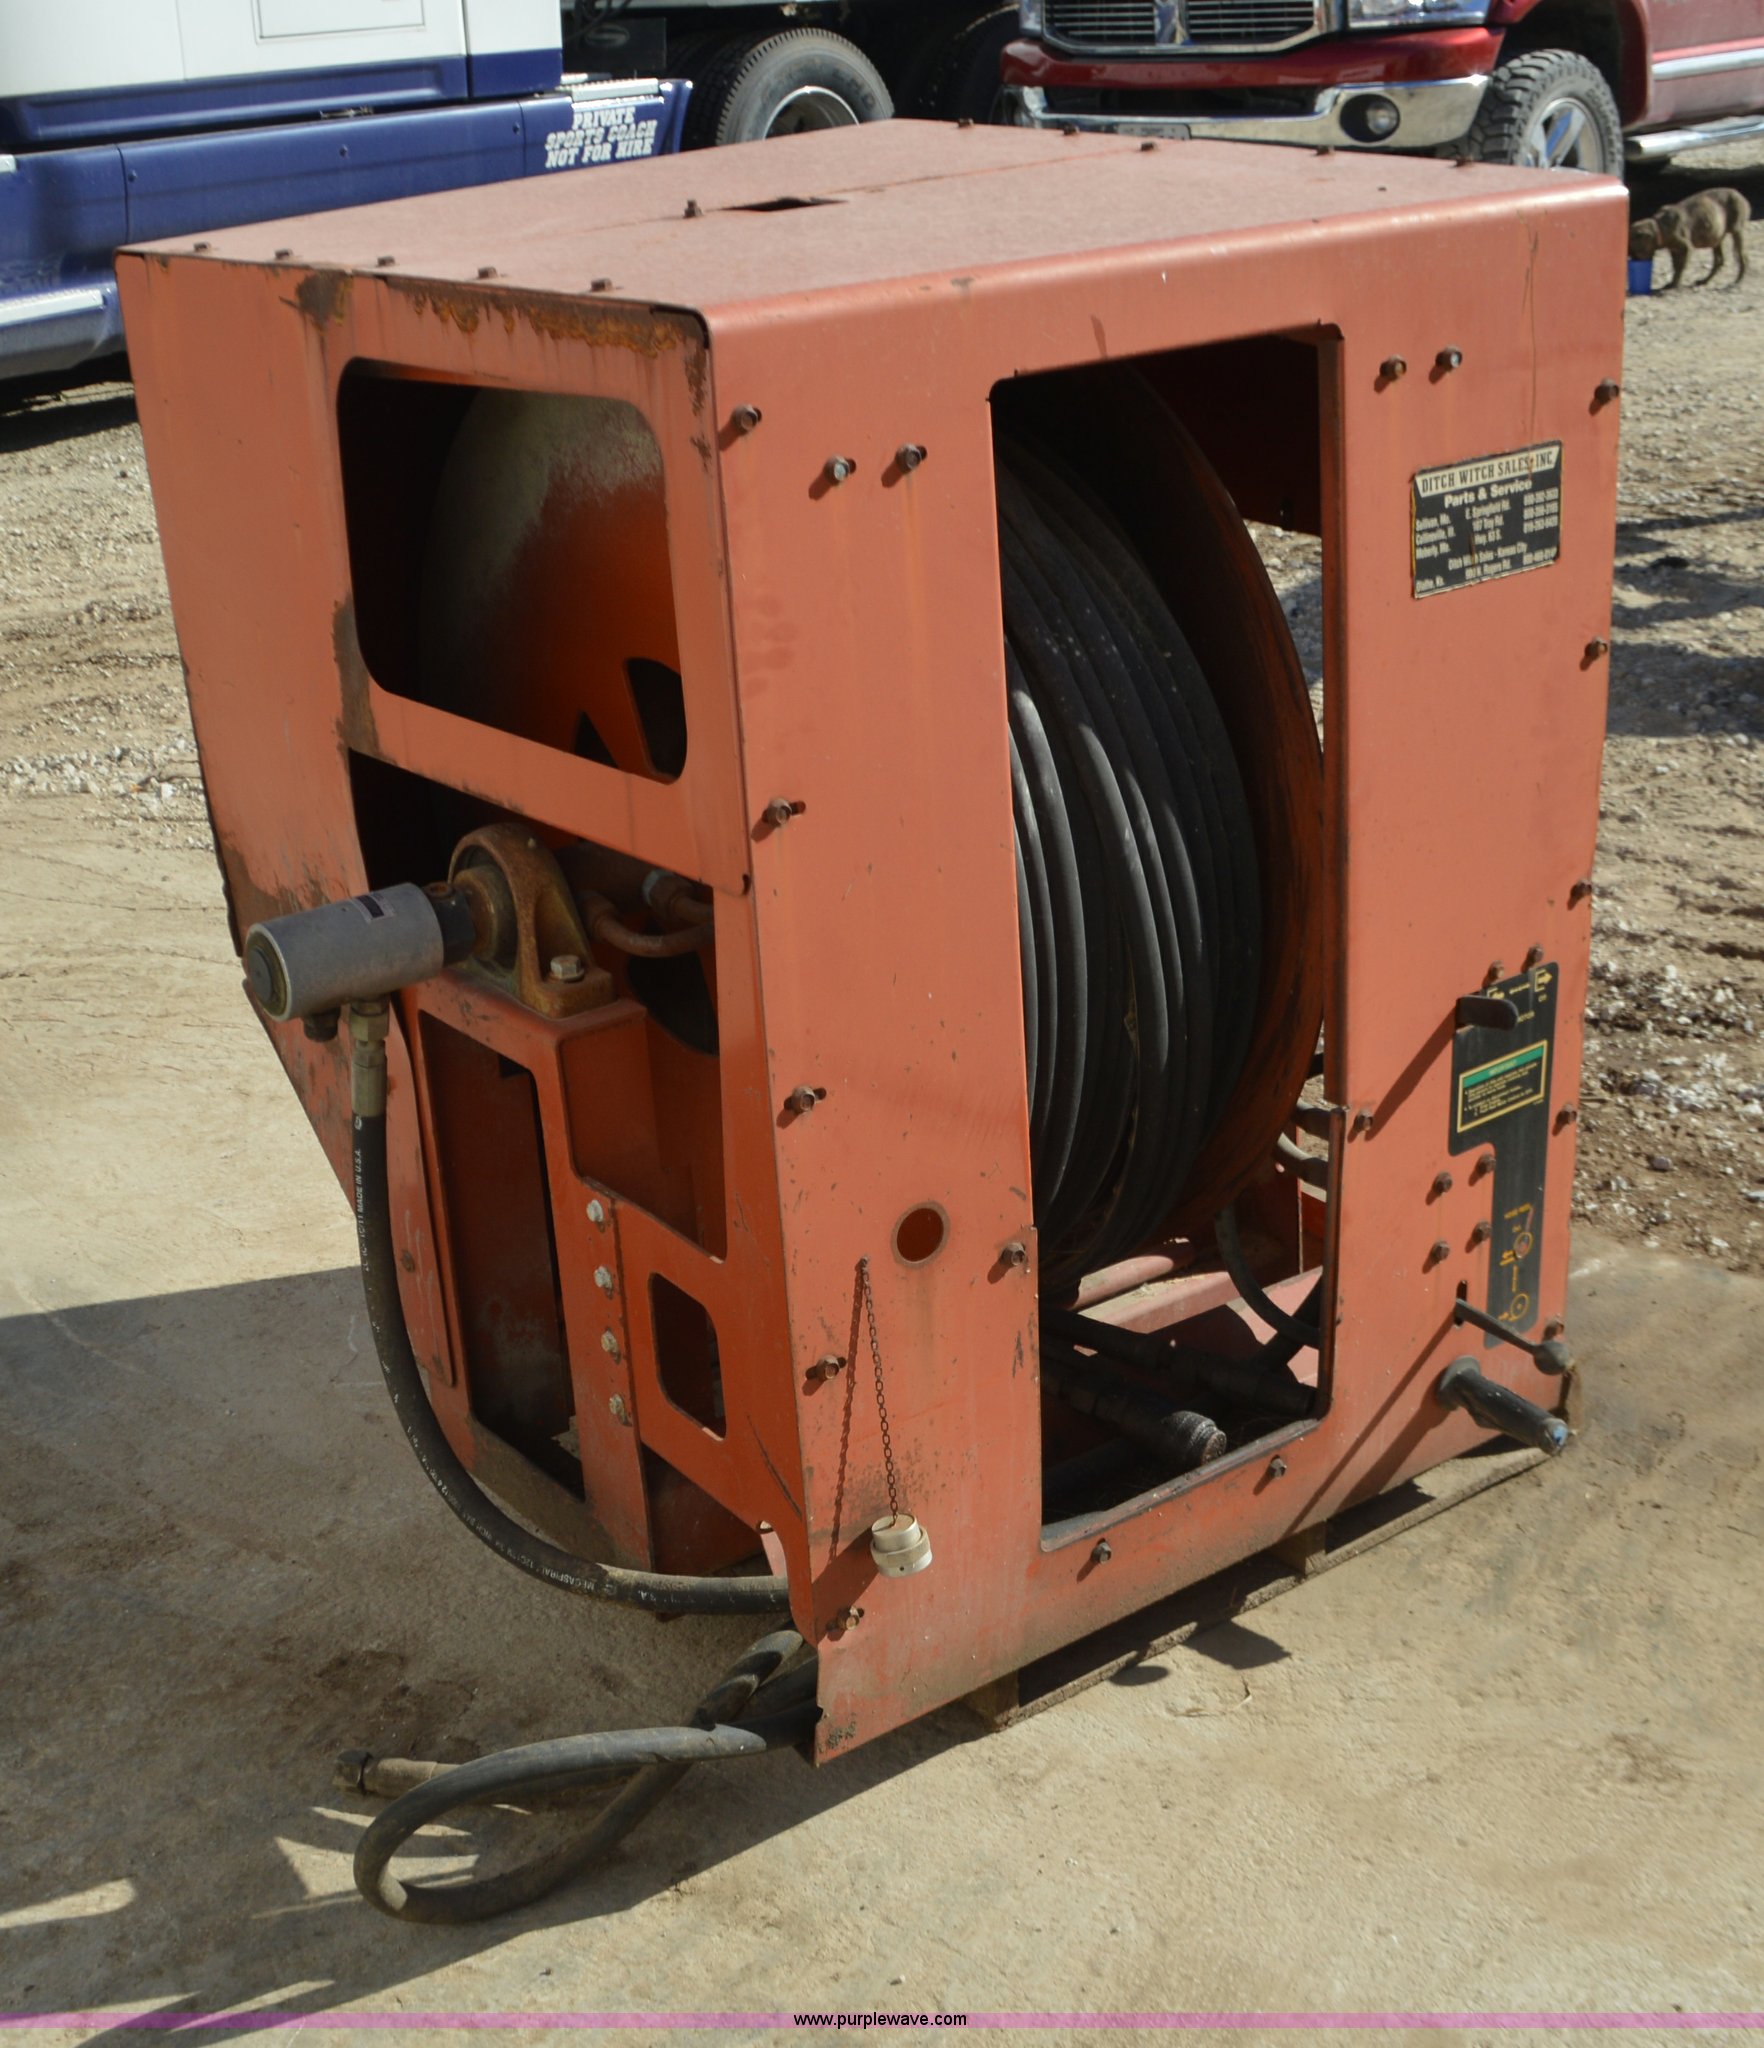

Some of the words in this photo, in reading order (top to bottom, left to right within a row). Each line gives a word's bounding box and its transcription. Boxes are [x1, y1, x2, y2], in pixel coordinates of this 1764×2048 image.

[572, 106, 636, 130] PRIVATE
[545, 126, 605, 151] SPORTS
[607, 119, 658, 142] COACH
[545, 147, 579, 168] NOT
[581, 142, 612, 164] FOR
[615, 136, 655, 159] HIRE
[1422, 474, 1455, 493] DITCH
[1459, 466, 1495, 484] WITCH
[1444, 492, 1475, 508] Parts
[1478, 487, 1487, 501] &
[1490, 479, 1532, 498] Service
[355, 1175, 362, 1185] IN
[355, 1187, 365, 1213] MADE
